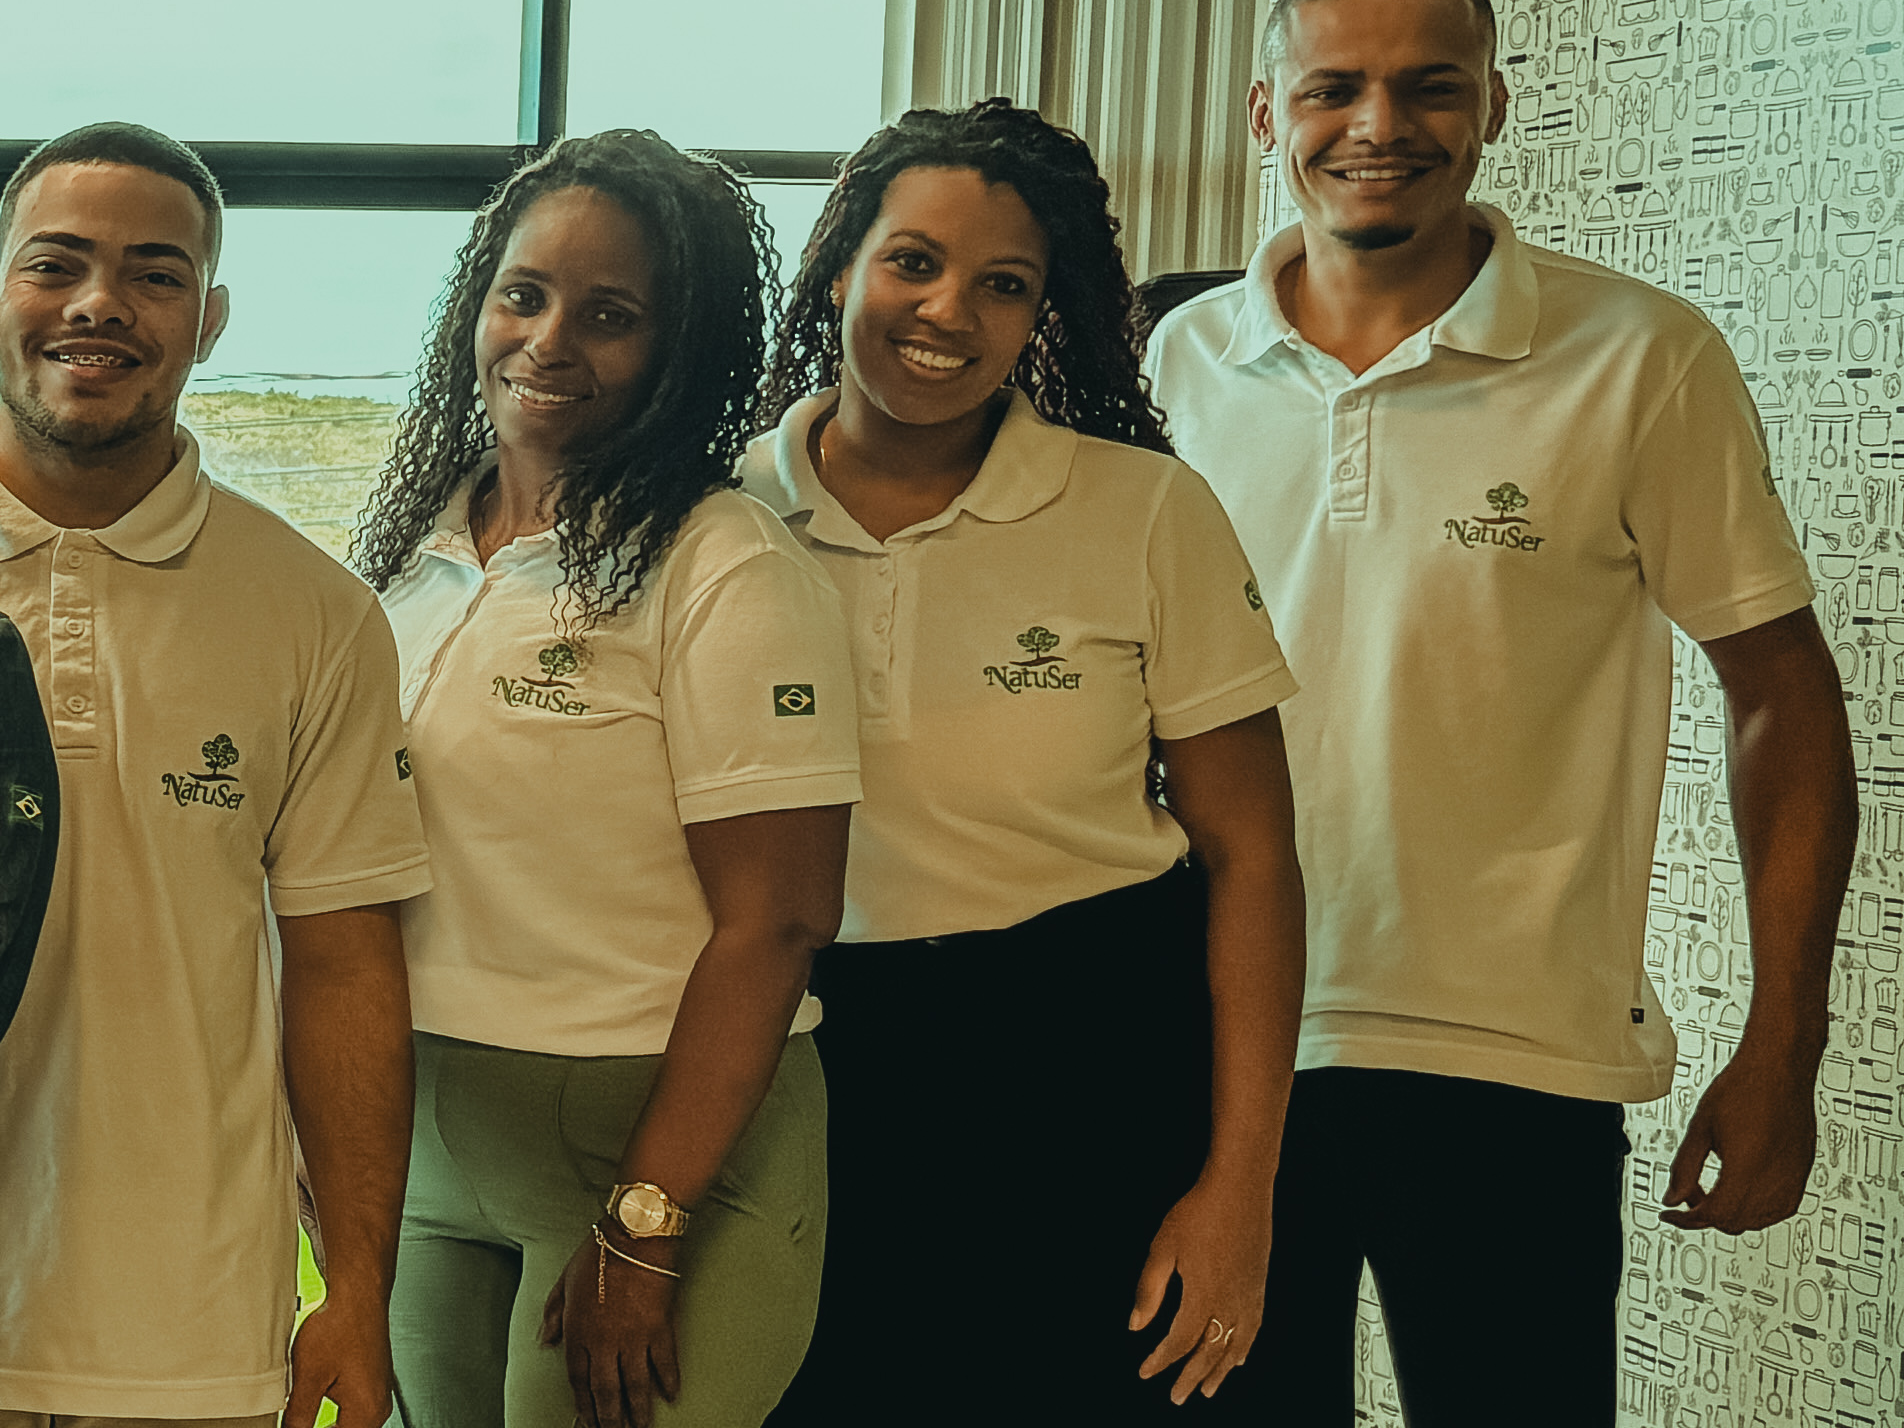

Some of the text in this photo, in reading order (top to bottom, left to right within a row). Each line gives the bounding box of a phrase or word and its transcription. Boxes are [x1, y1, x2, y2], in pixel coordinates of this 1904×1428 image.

[1444, 519, 1546, 553] NatuSer
[492, 676, 591, 717] NatuSer
[983, 665, 1083, 695] NatuSer
[161, 772, 246, 811] NatuSer
